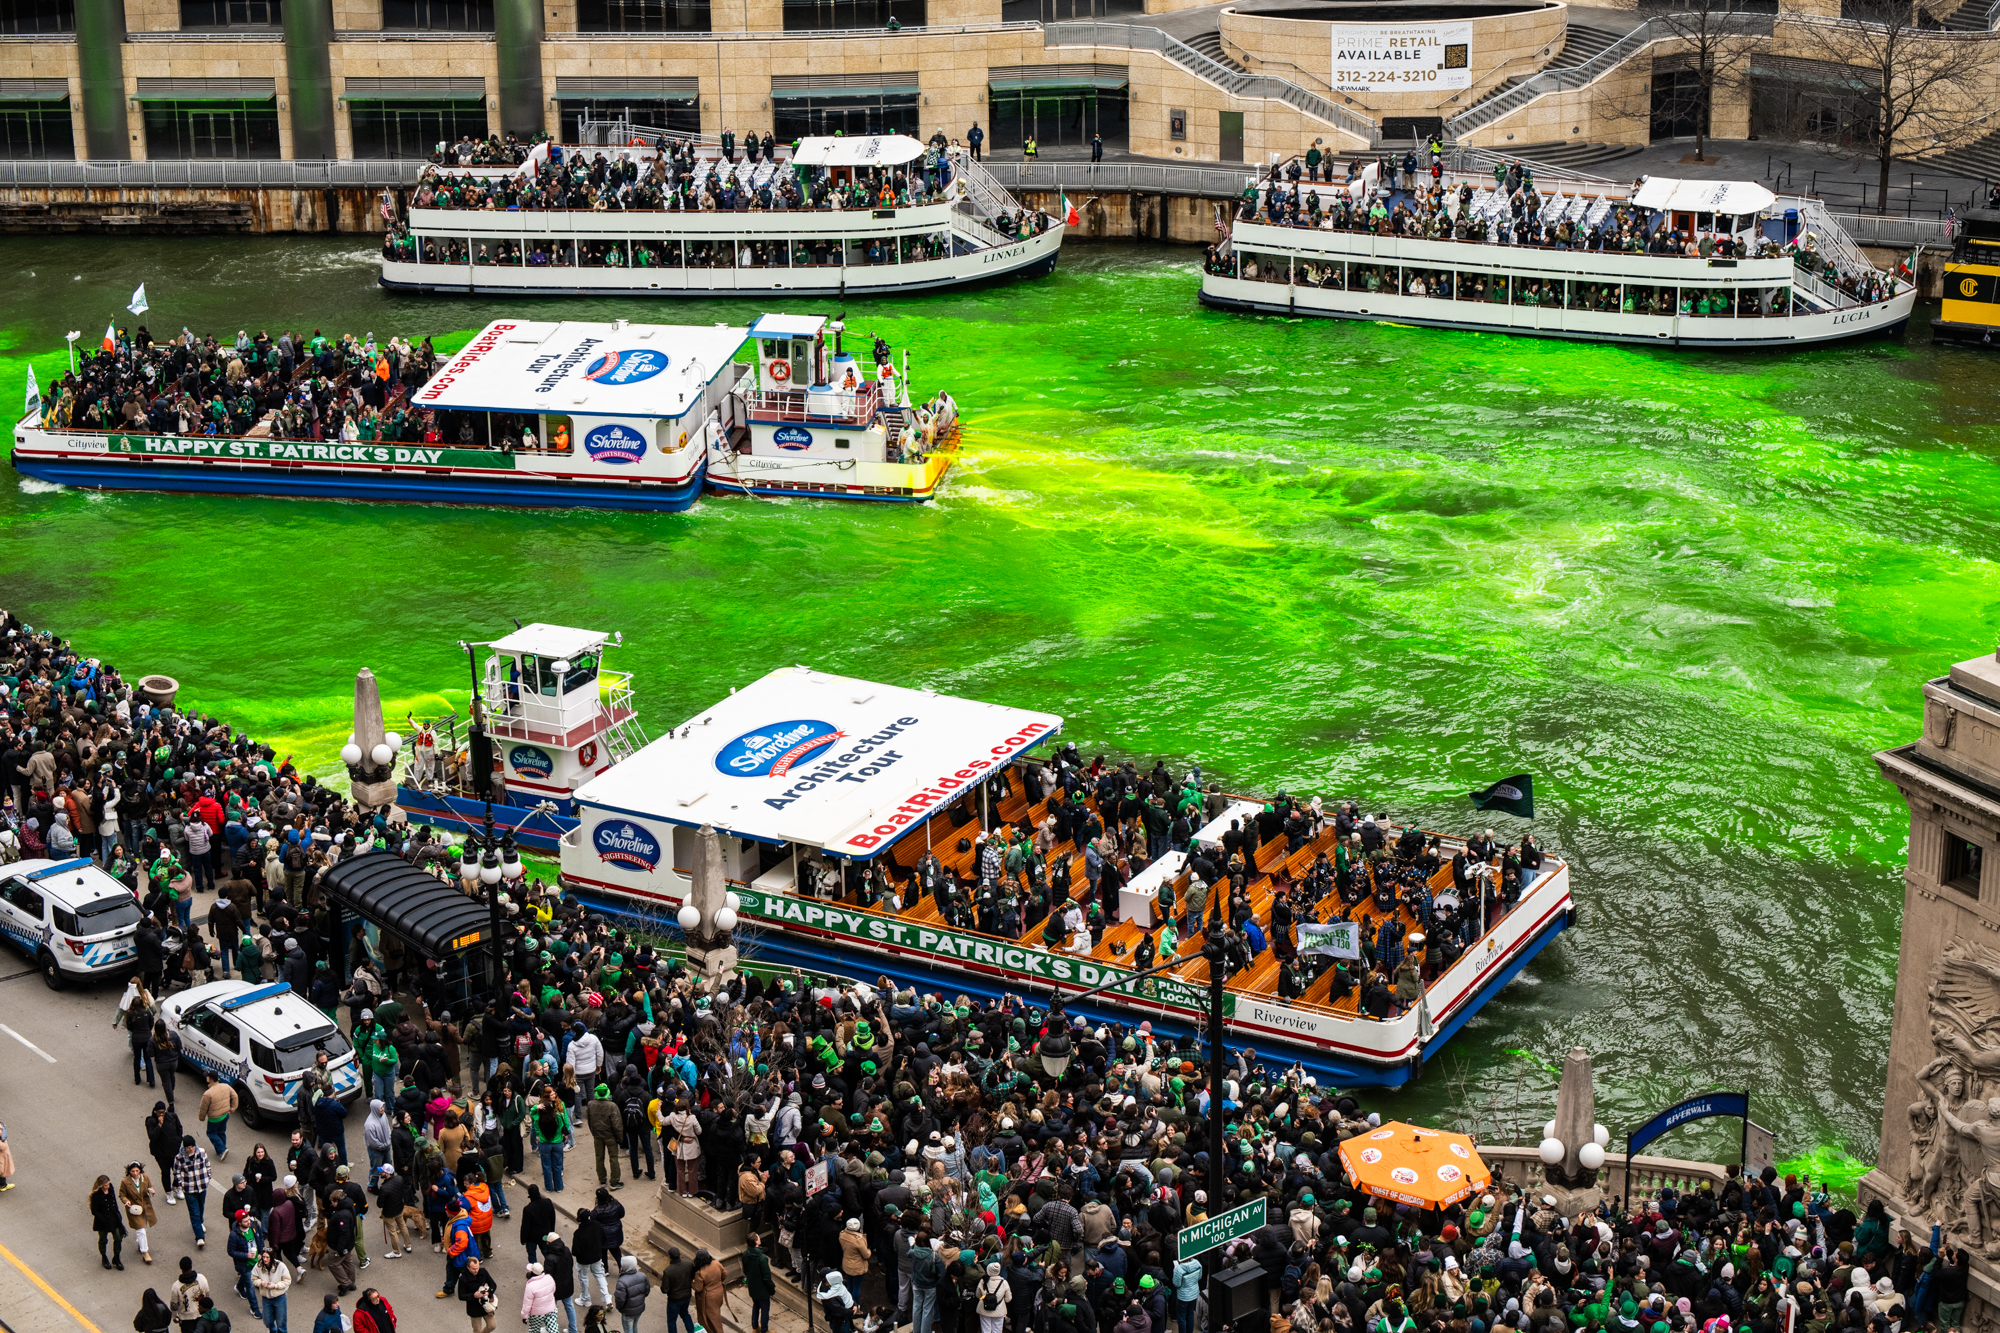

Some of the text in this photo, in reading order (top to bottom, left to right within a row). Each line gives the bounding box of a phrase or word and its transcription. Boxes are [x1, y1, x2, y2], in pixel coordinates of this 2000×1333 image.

[1337, 37, 1441, 48] PRIME RETAIL
[1337, 50, 1421, 60] AVAILABLE
[1336, 70, 1437, 82] 312-224-3210
[983, 246, 1026, 264] LINNEA
[1832, 310, 1871, 325] LUCIA
[420, 324, 517, 400] BoatRides.com
[526, 353, 562, 374] Tour
[535, 337, 604, 393] Architecture
[67, 439, 107, 450] Cityview
[590, 434, 640, 450] Shoreline
[777, 432, 809, 442] Shoreline
[145, 438, 444, 464] HAPPY ST. PATRICK'S DAY
[593, 450, 639, 462] SIGHTSEEING
[749, 459, 783, 470] Cityview
[730, 723, 815, 773] Shoreline
[773, 732, 840, 775] SIGHTSEEING
[513, 752, 549, 768] Shoreline
[763, 716, 919, 811] Architecture
[835, 749, 904, 784] Tour
[846, 722, 1050, 850] BoatRides.com
[930, 757, 1012, 816] SHORELINE SIGHTSEEING
[599, 829, 654, 855] Shoreline
[602, 852, 652, 870] SIGHTSEEING
[1304, 929, 1350, 942] PLUMBERS
[1304, 938, 1350, 950] LOCAL 130
[764, 897, 1138, 993] HAPPY ST. PATRICK'S DAY
[1475, 941, 1504, 974] Riverview
[1160, 991, 1200, 1007] LOCAL
[1253, 1008, 1318, 1032] Riverview
[1665, 1103, 1712, 1127] RIVERWALK
[1673, 1099, 1706, 1114] CHICAGO
[1371, 1185, 1425, 1207] TOAST OF CHICAGO
[1444, 1192, 1458, 1206] TOAST
[1458, 1189, 1465, 1199] OF
[1181, 1204, 1263, 1245] N MICHIGAN AV
[1210, 1227, 1235, 1244] 100 E
